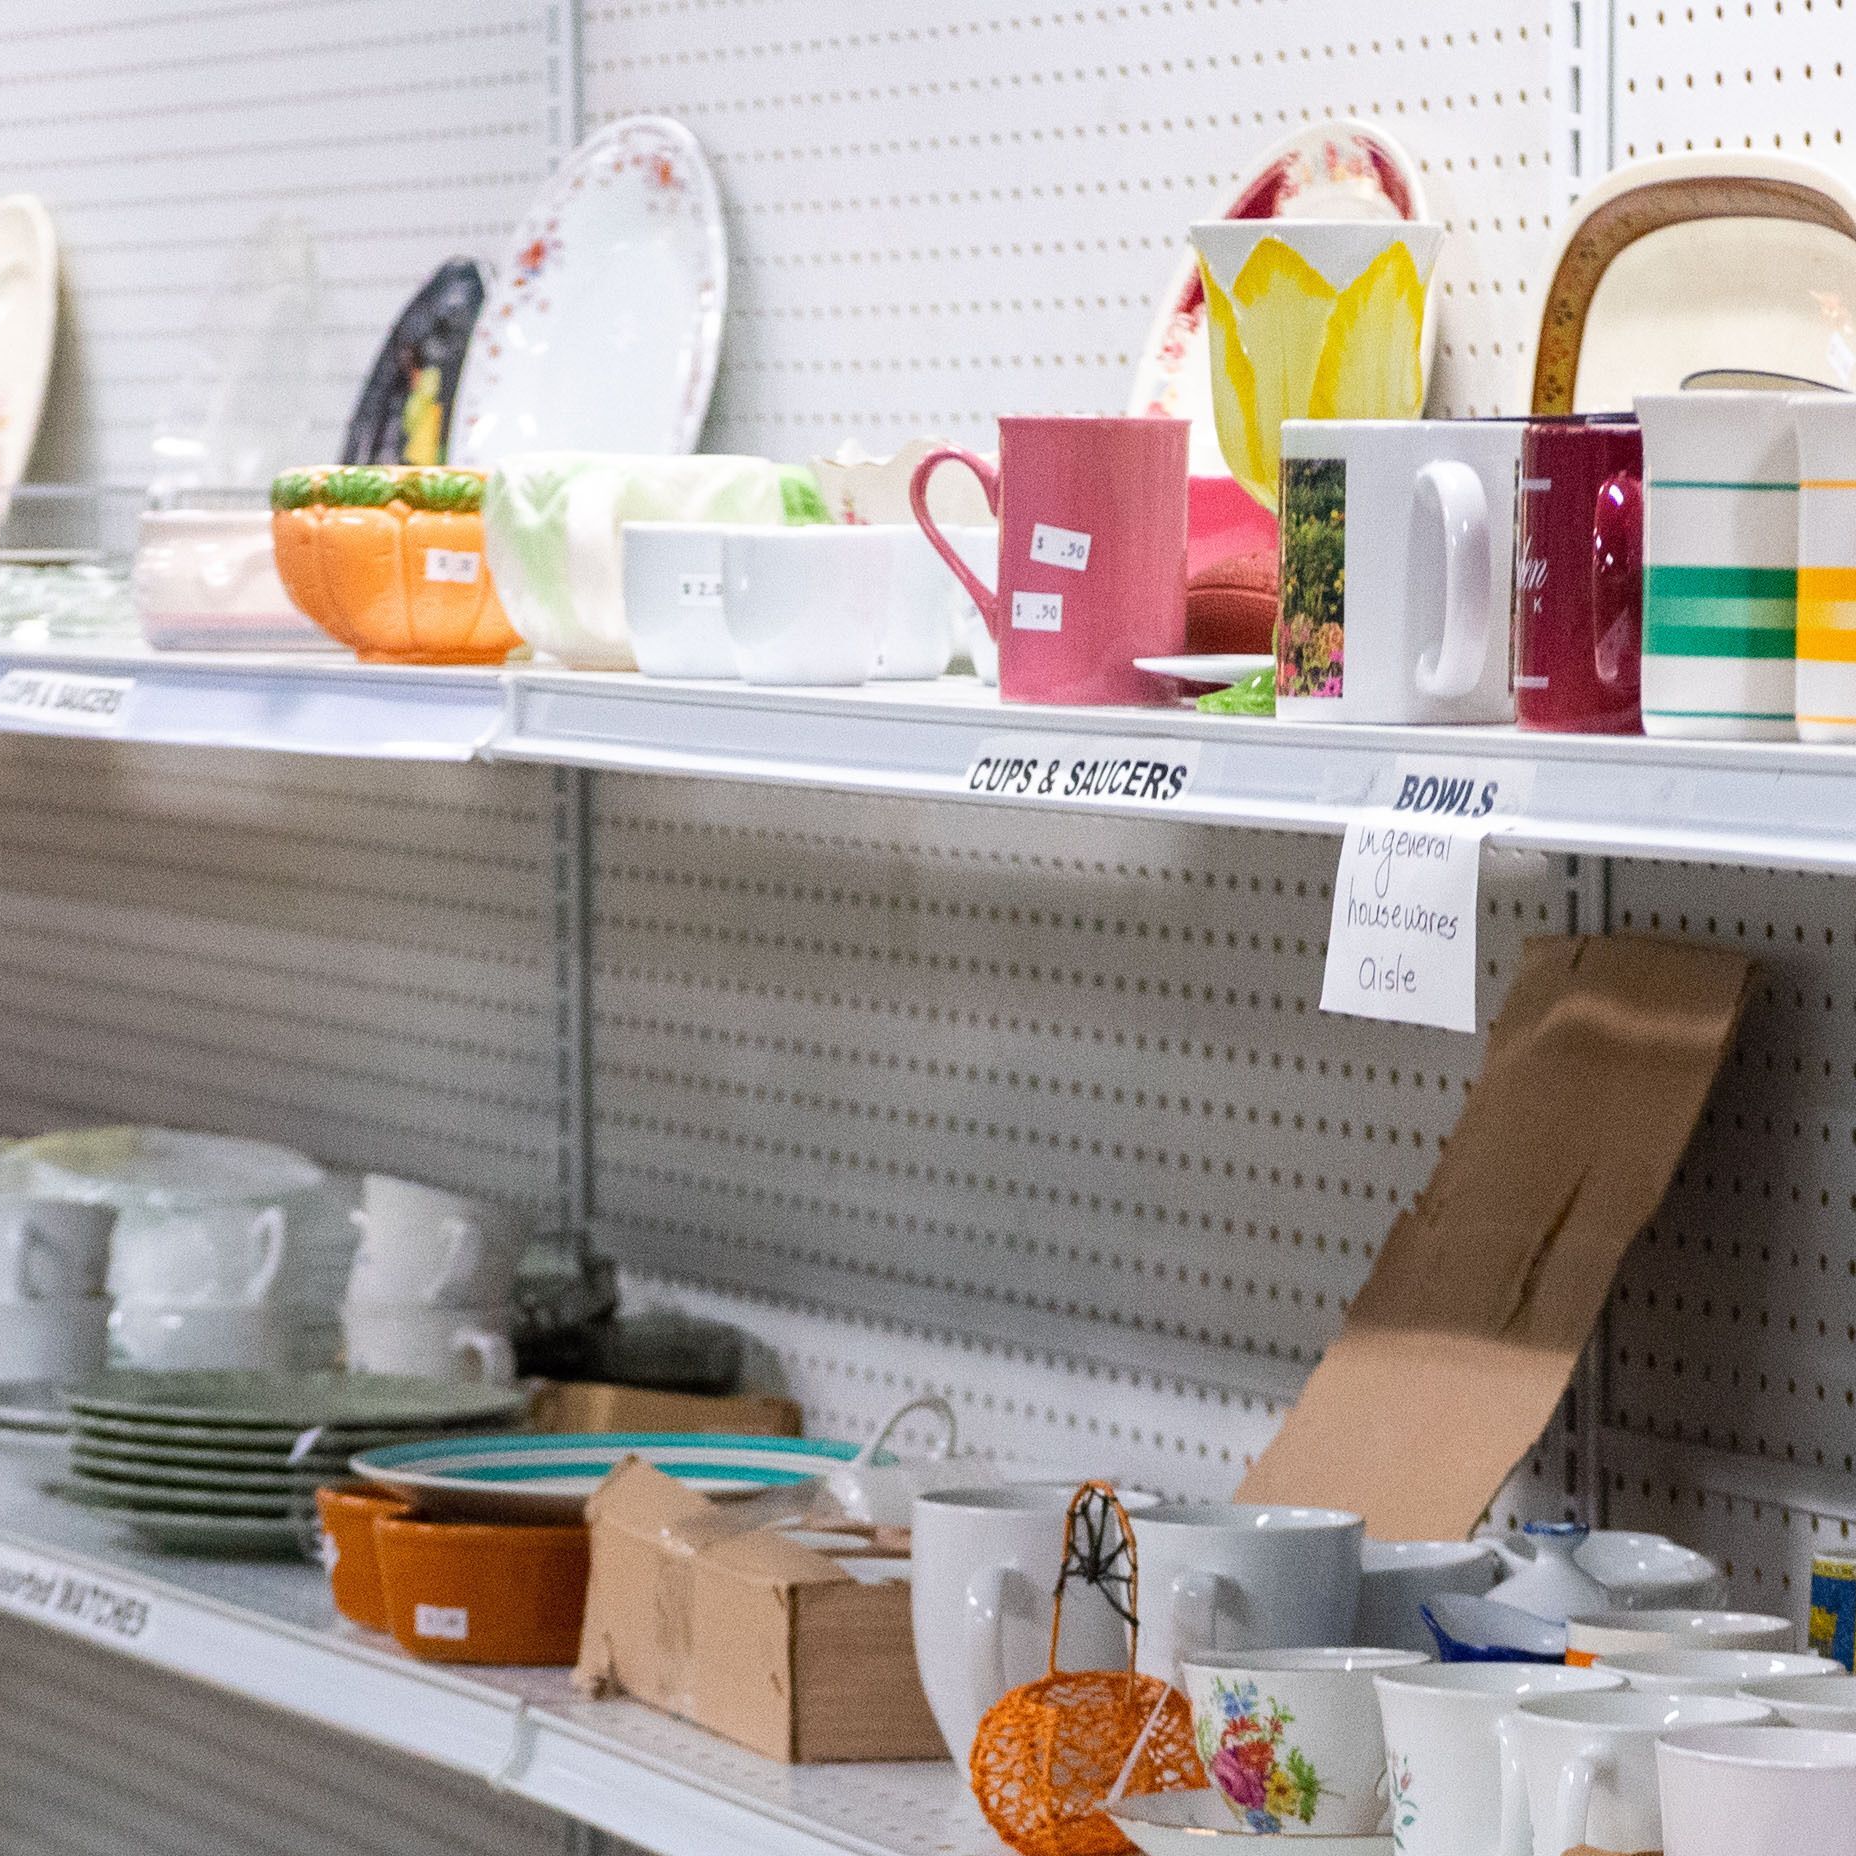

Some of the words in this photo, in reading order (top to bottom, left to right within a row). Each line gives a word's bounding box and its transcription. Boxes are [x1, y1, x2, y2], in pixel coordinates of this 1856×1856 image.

[970, 757, 1038, 794] CUPS
[1038, 759, 1061, 795] &
[1063, 759, 1189, 801] SAUCERS
[1393, 773, 1499, 819] BOWLS
[1375, 828, 1454, 899] general
